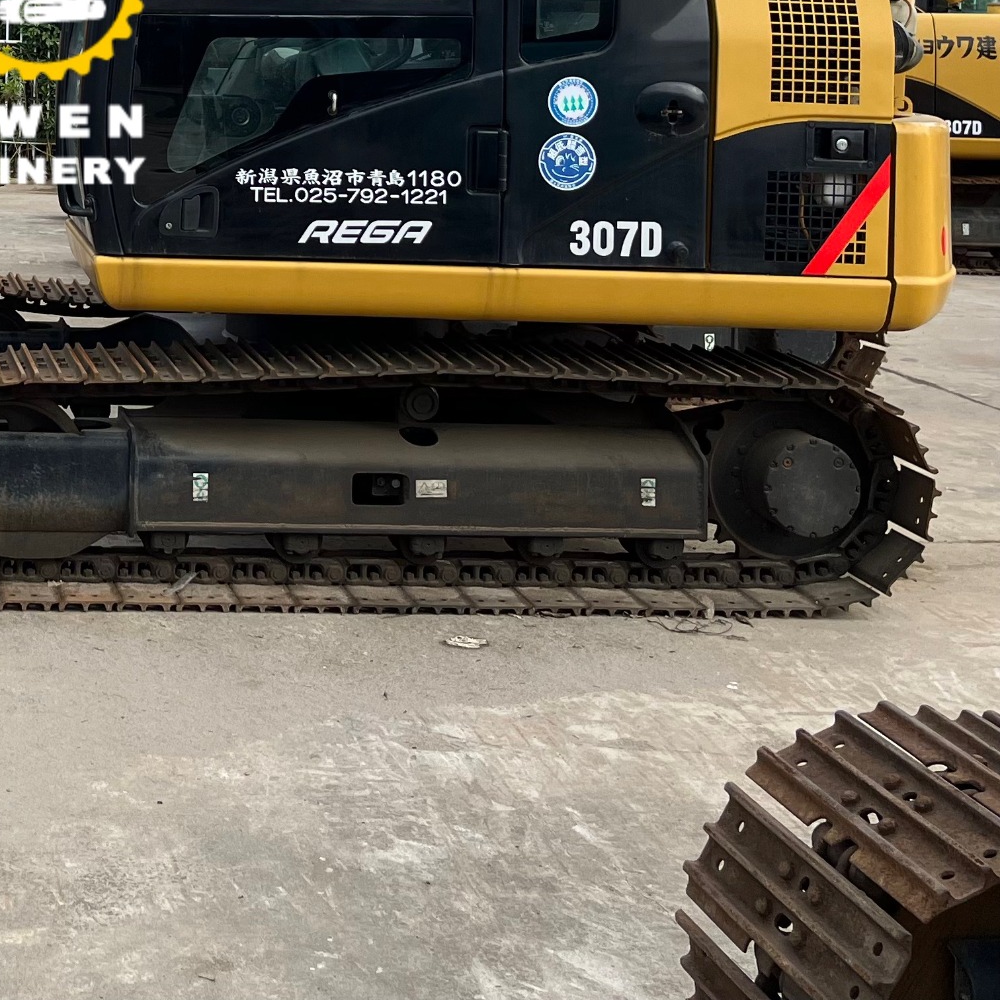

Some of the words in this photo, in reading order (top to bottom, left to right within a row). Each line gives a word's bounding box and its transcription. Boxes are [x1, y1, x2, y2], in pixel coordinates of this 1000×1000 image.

[249, 186, 448, 205] TEL.025-792-1221
[297, 219, 433, 244] REGA
[569, 219, 663, 258] 307D
